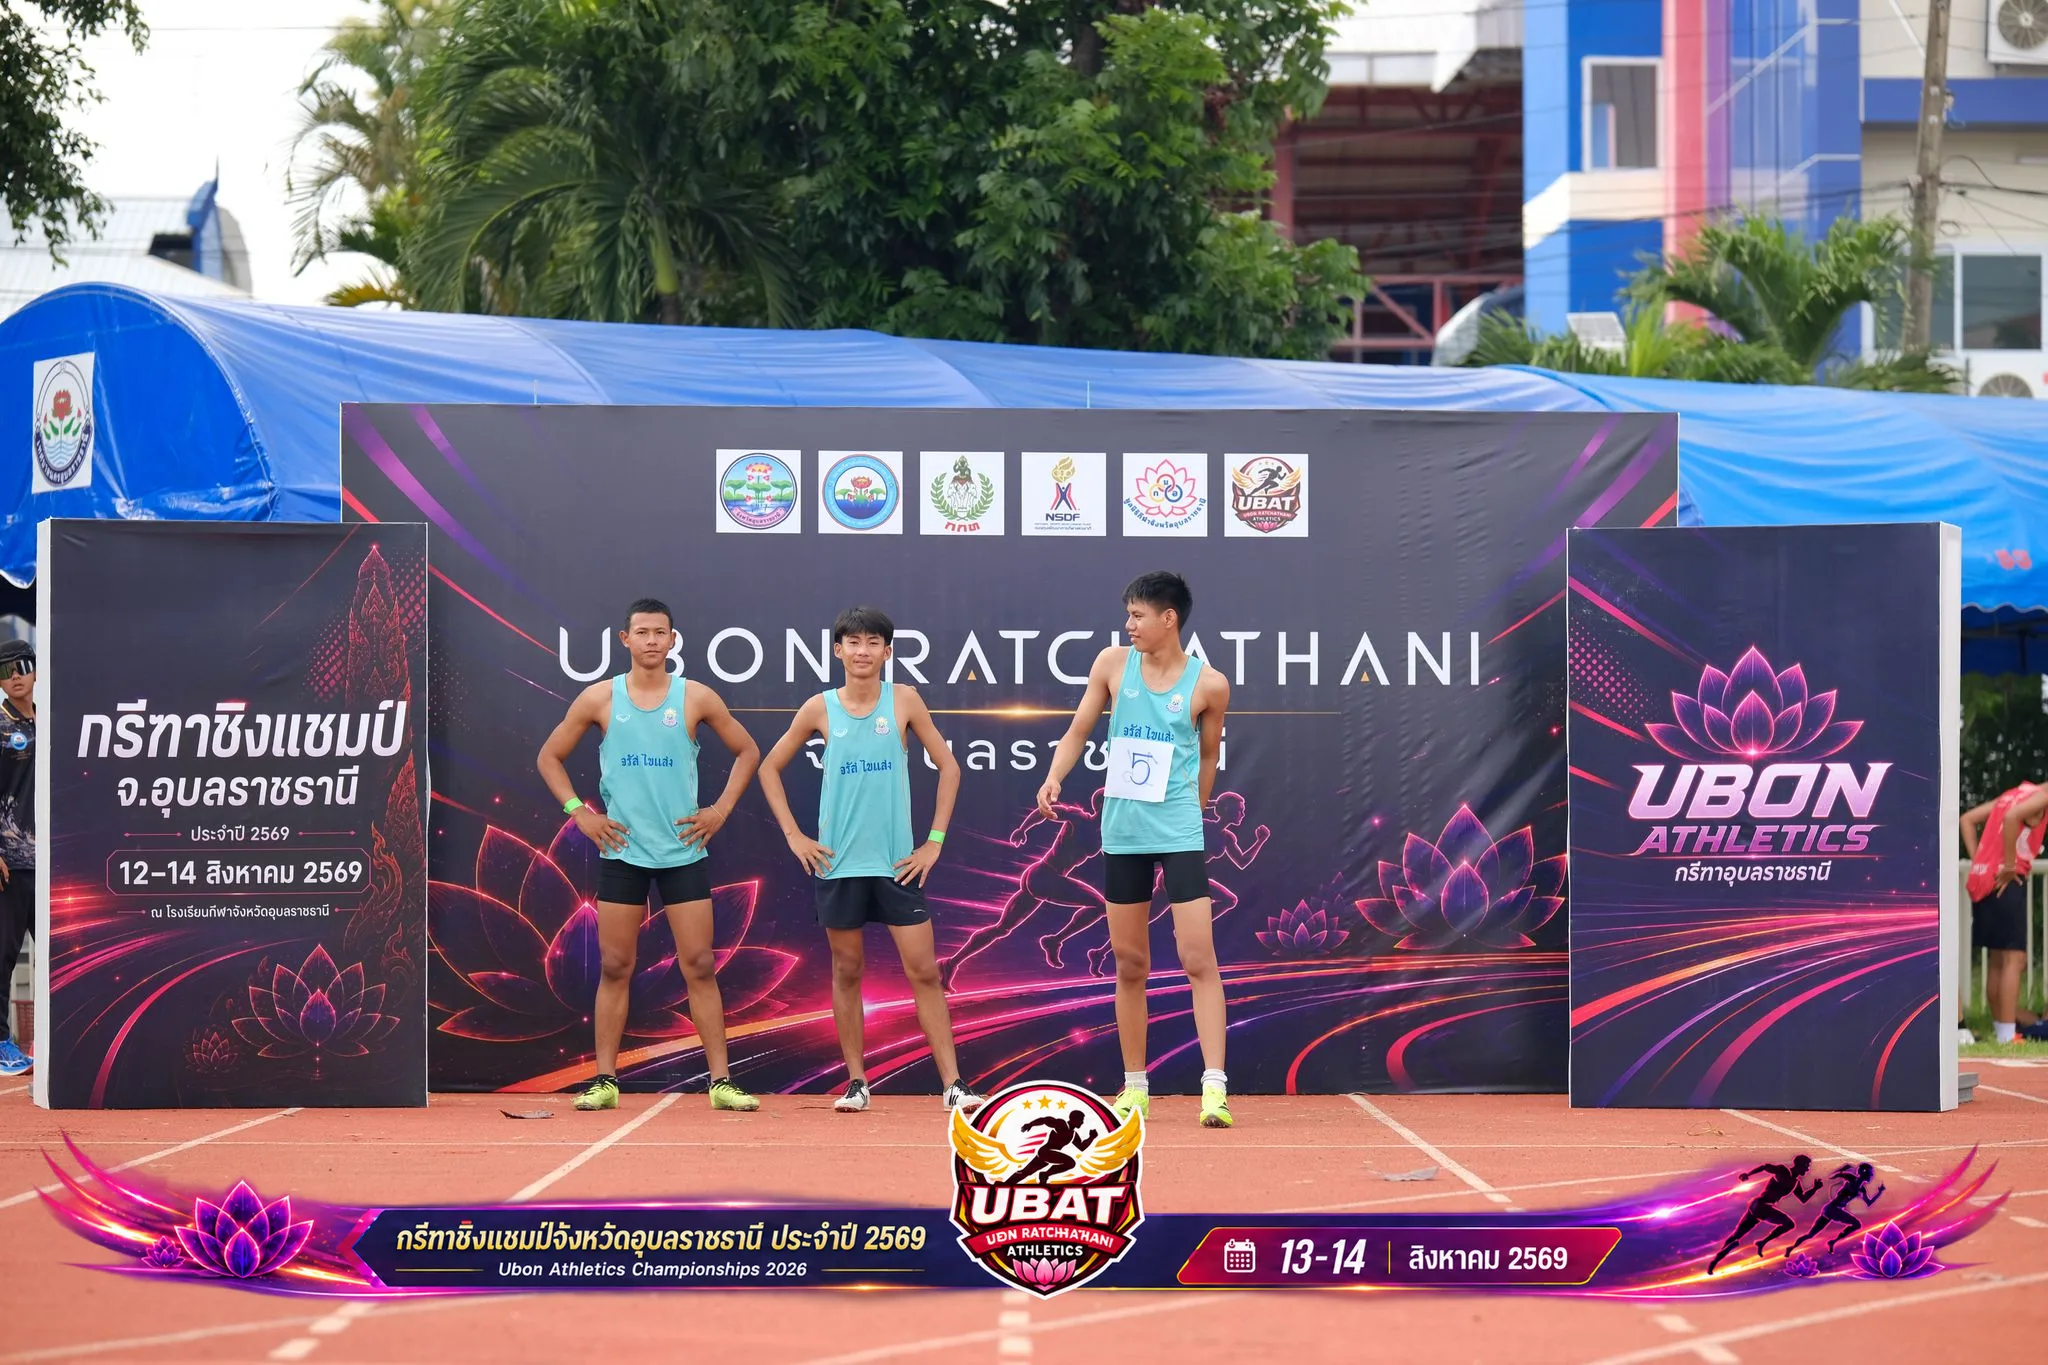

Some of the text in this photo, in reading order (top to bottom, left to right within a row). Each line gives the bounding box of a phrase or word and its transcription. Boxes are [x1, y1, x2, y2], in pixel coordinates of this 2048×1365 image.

[1045, 513, 1081, 521] NSDF
[1237, 496, 1296, 511] UBAT
[944, 521, 981, 533] กกท
[884, 629, 1480, 686] RATCATHANI
[77, 698, 407, 758] กรีฑาชิงแชมป์
[1129, 752, 1153, 786] 5
[117, 765, 360, 819] จ.อุบลราชธานี
[1628, 762, 1894, 820] UBON
[191, 825, 290, 842] ประจำปี 2569
[1636, 824, 1880, 855] ATHLETICS
[119, 859, 363, 885] 12-14 สิงหาคม 2569
[151, 908, 162, 918] ณ
